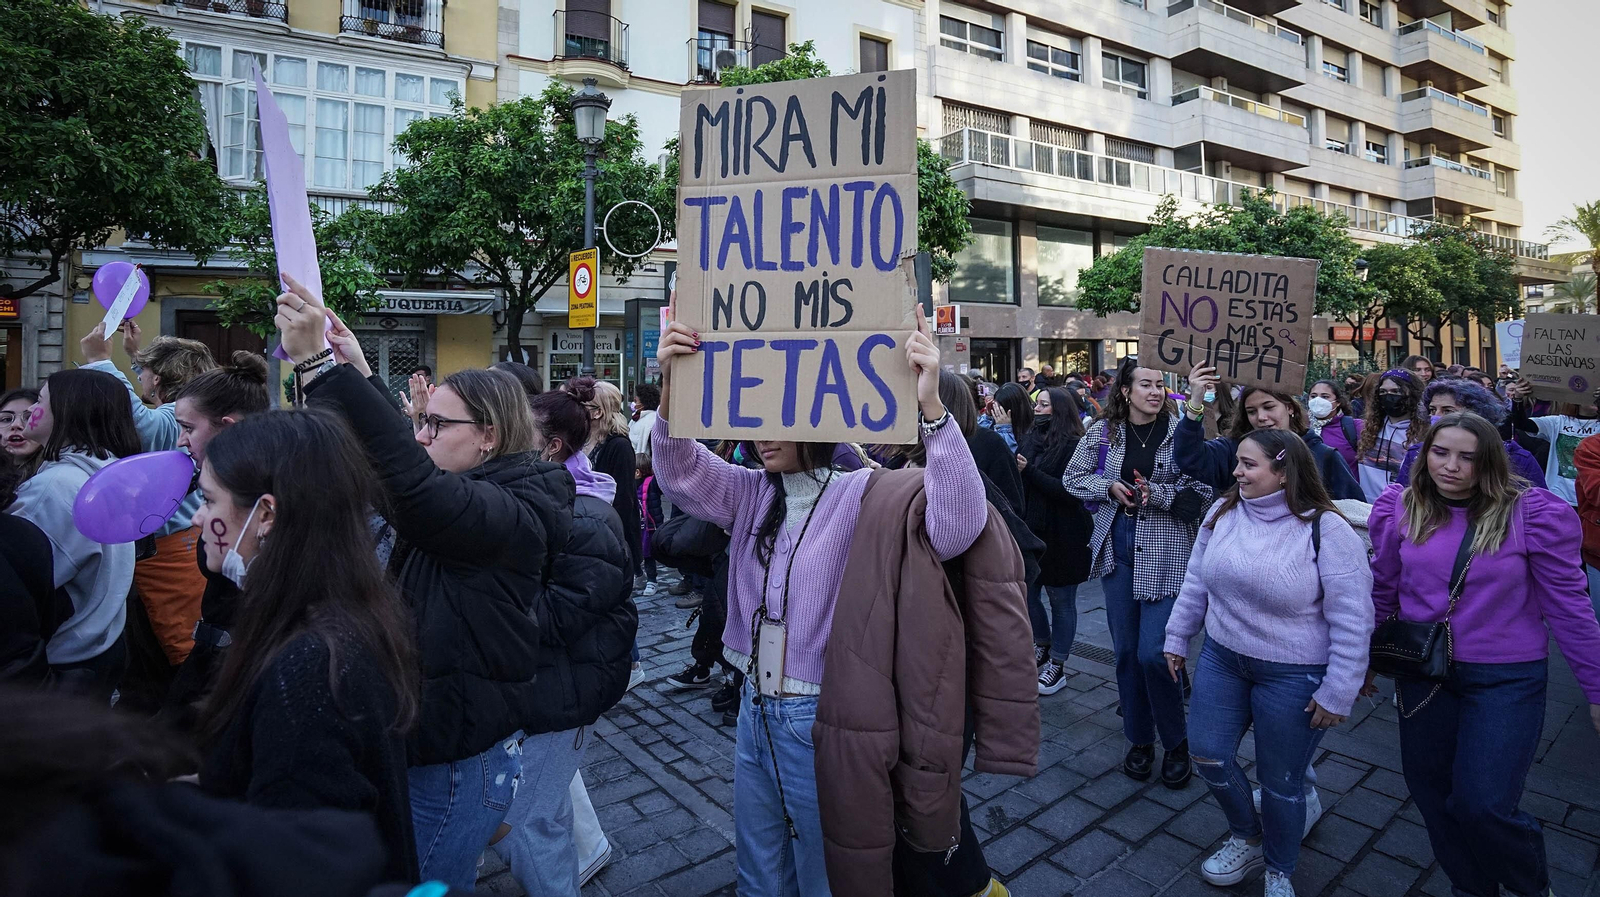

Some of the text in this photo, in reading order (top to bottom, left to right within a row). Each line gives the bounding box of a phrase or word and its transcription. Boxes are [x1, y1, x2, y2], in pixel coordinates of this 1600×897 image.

[694, 87, 817, 178] MIRA
[683, 180, 904, 272] TALENTO
[712, 271, 854, 331] NO MIS
[1162, 264, 1290, 300] CALLADITA
[1159, 290, 1299, 333] NO ESTÁS
[1157, 329, 1284, 383] GUAPA
[1226, 322, 1276, 348] MÁS
[1533, 328, 1586, 341] FALTAN
[1548, 343, 1573, 356] LAS
[697, 333, 898, 432] TETAS
[1526, 354, 1596, 370] ASESINADAS
